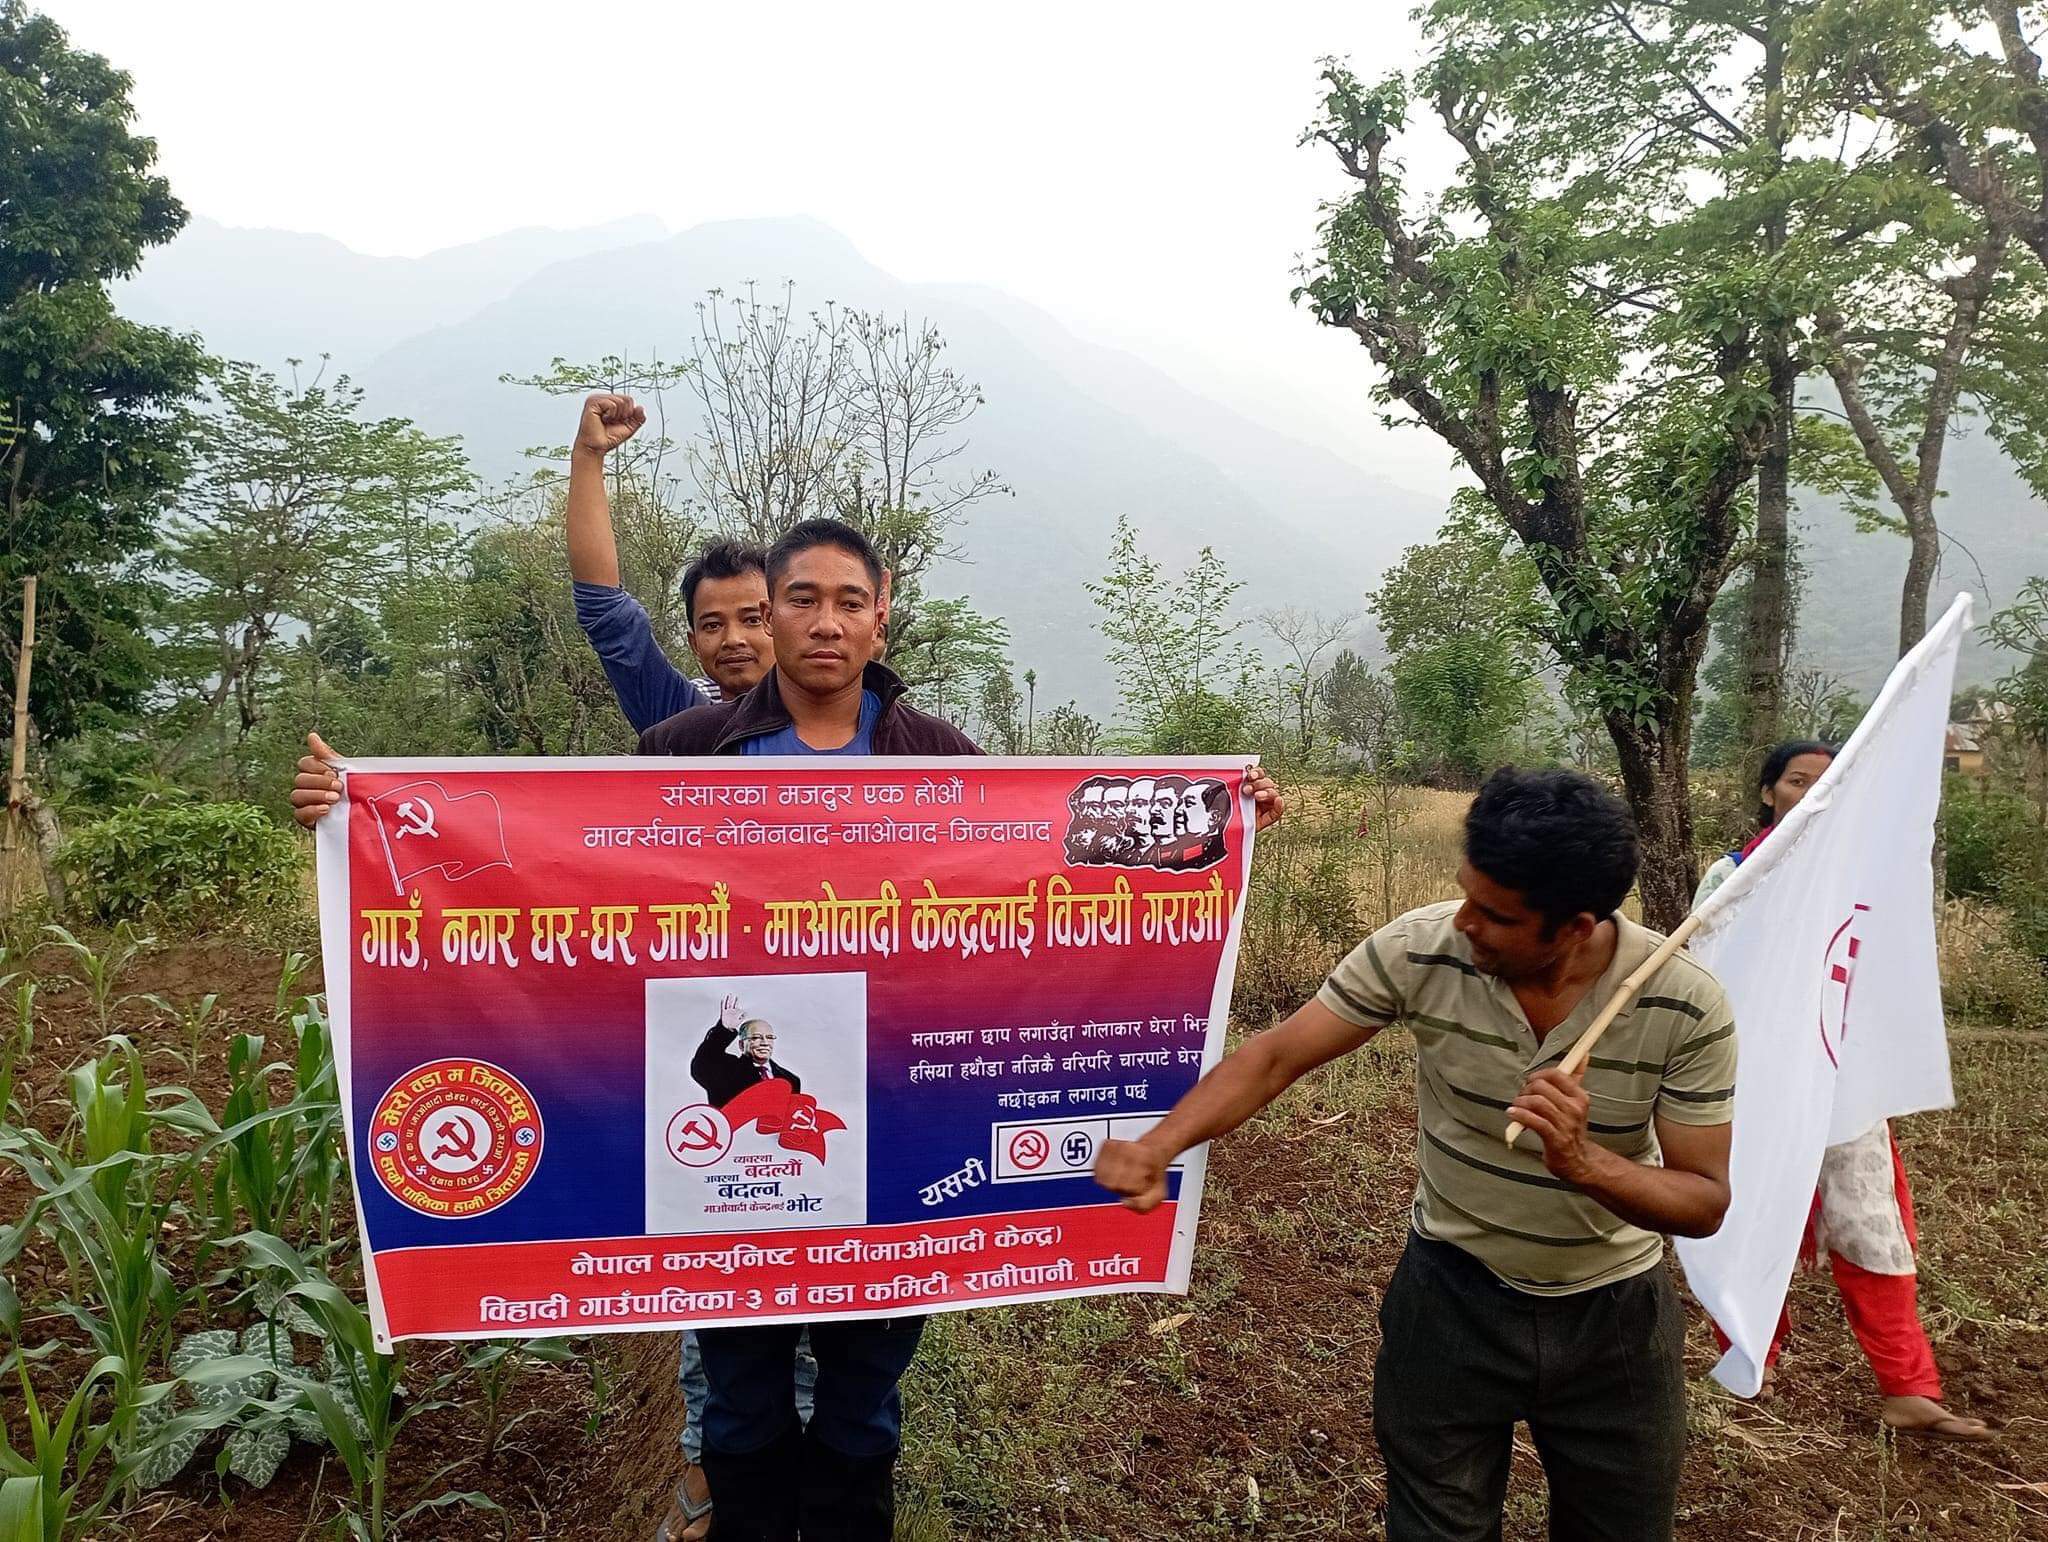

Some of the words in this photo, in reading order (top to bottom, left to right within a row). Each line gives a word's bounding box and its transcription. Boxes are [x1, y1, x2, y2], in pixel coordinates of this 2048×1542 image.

[660, 780, 769, 806] संसारका
[778, 784, 854, 811] मजदुर
[863, 785, 906, 805] एक
[914, 776, 965, 806] होऔं
[441, 907, 521, 968] नगर
[530, 905, 640, 967] घर-घर
[763, 879, 901, 959] माओवादी
[911, 879, 1038, 959] केन्द्रलाई
[1046, 874, 1134, 948] विजयी
[911, 1029, 974, 1049] मतपत्रमा
[980, 1026, 1012, 1046] छाप
[1018, 1019, 1075, 1044] लगाउँदा
[1081, 1020, 1143, 1040] गोलाकार
[1149, 1016, 1176, 1038] घेरा
[909, 1060, 953, 1082] हसिया
[960, 1055, 1004, 1081] हथौडा
[1011, 1052, 1055, 1076] नजिकै
[1062, 1050, 1113, 1074] वरिपरि
[1119, 1047, 1171, 1070] चारपाटे
[379, 1089, 412, 1127] मेरो
[409, 1069, 442, 1093] वडा
[447, 1068, 466, 1083] म
[997, 1088, 1061, 1110] नछोइकन
[1068, 1085, 1118, 1107] लगाउनु
[1124, 1079, 1149, 1102] पर्छ
[733, 1154, 773, 1164] व्यवस्था
[745, 1158, 804, 1178] बदल्यौं
[704, 1174, 740, 1183] अवस्था
[918, 1157, 987, 1207] यसरी
[401, 1186, 450, 1213] पालिका
[453, 1195, 486, 1213] हामी
[704, 1201, 747, 1214] माओवादी
[786, 1193, 824, 1213] भोट
[570, 1251, 654, 1276] नेपाल
[662, 1243, 798, 1275] कम्युनिष्ट
[806, 1228, 986, 1266] पार्टी(माओवादी
[993, 1224, 1062, 1250] केन्द्र)
[479, 1293, 569, 1323] विहादी
[578, 1286, 763, 1317] गाउँपालिका-३
[774, 1282, 798, 1307] नं
[807, 1284, 856, 1305] वडा
[1088, 1255, 1142, 1278] पर्वत
